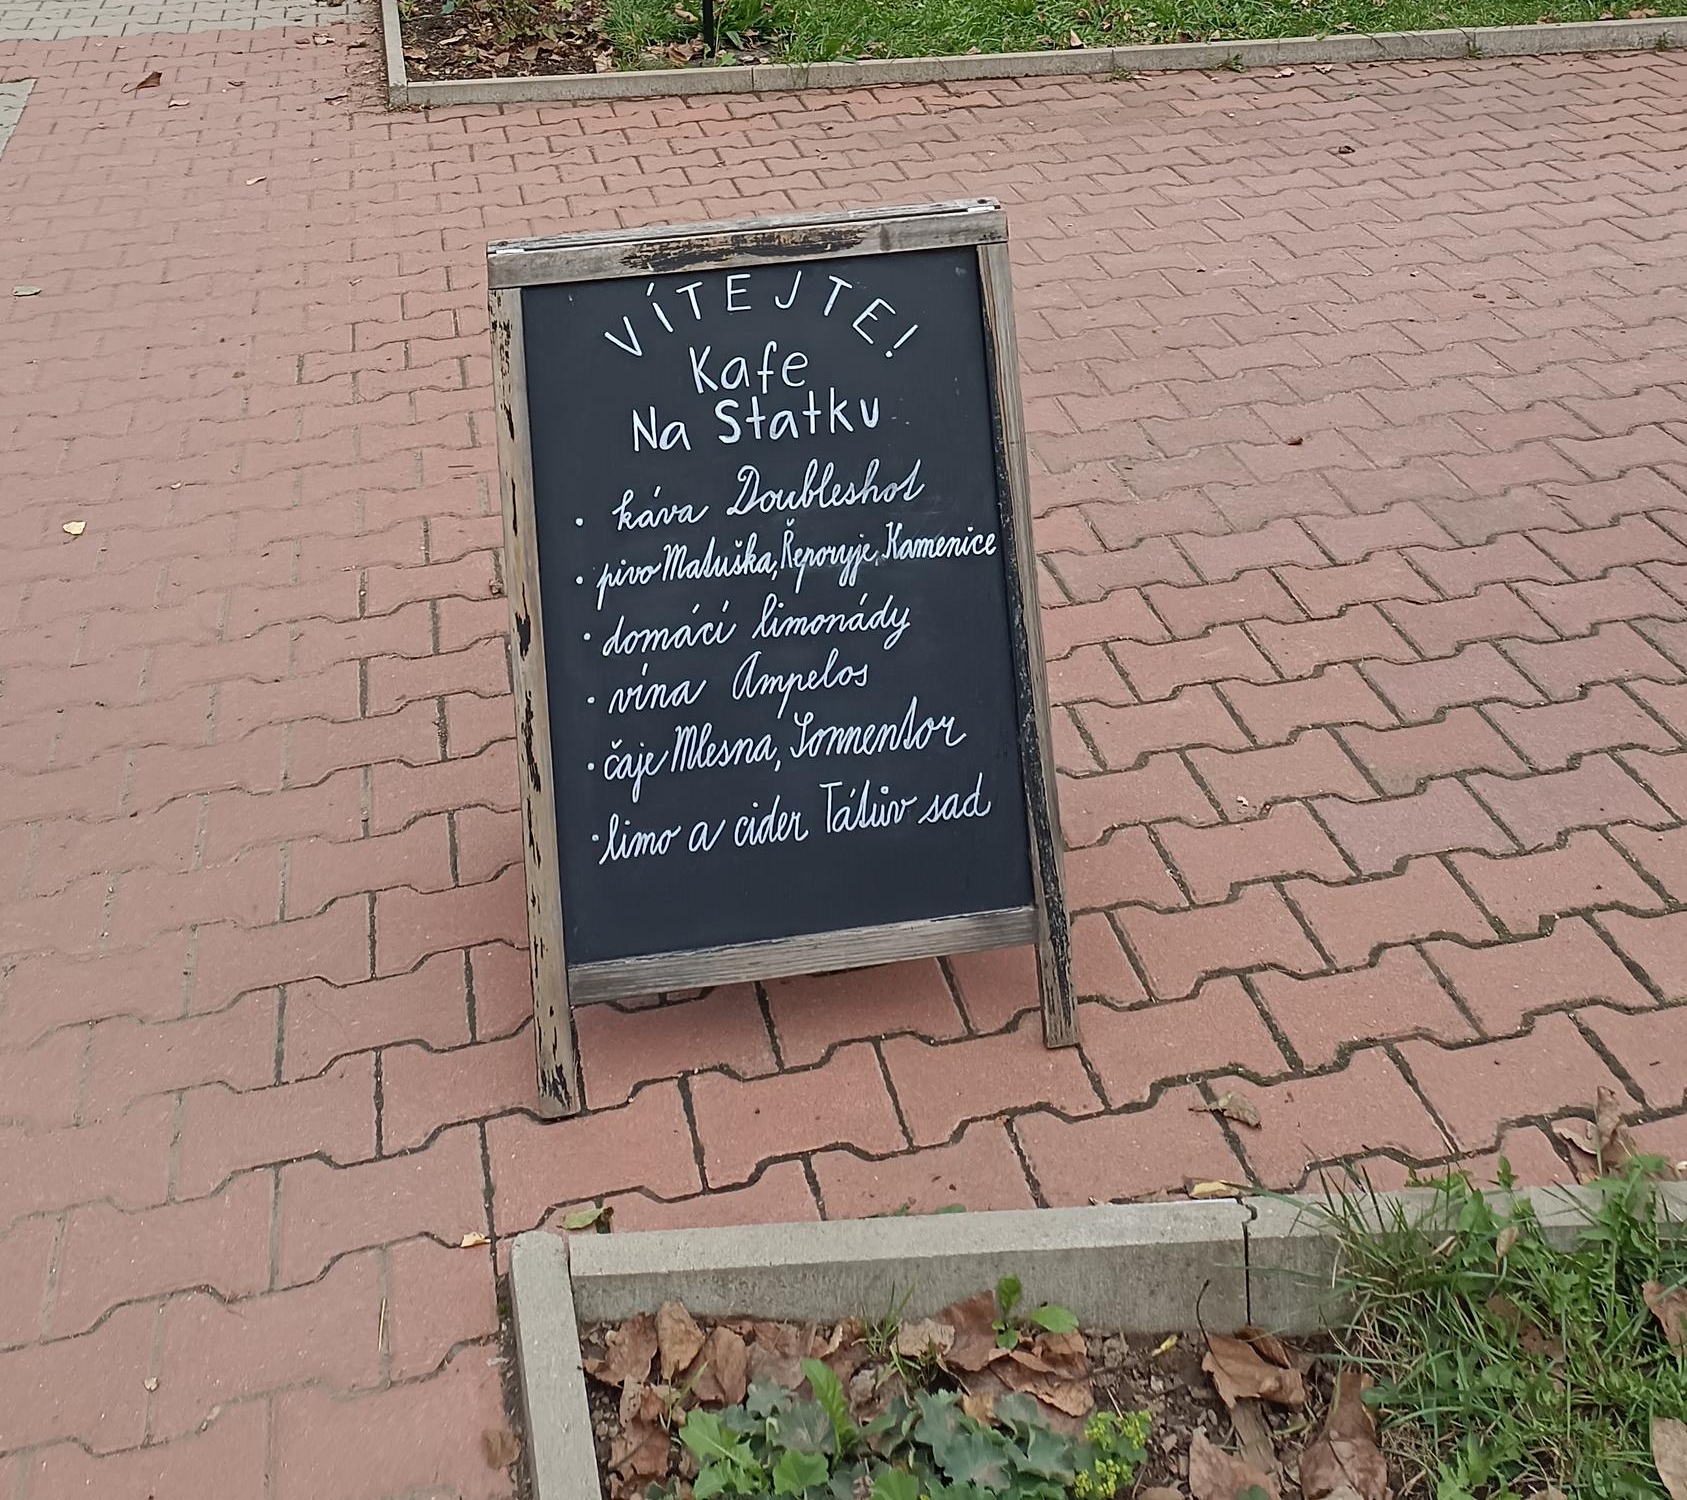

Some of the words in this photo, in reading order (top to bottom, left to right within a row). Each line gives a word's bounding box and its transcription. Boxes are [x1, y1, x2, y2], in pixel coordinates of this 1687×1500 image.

[604, 270, 919, 359] VÍTEJTE!
[689, 340, 808, 395] Kafe
[632, 406, 691, 453] Na
[716, 387, 880, 445] Statku
[612, 486, 710, 531] káva
[726, 458, 925, 517] Doubleshot
[596, 558, 662, 610] pivo
[882, 521, 997, 560] Kamenice
[602, 600, 737, 657] domácí
[752, 593, 911, 650] limonády
[608, 663, 707, 714] vína
[732, 648, 868, 719] Ampelos
[603, 739, 669, 803] čaje
[599, 813, 681, 865] limo
[688, 819, 726, 852] a
[734, 795, 809, 847] cider
[917, 772, 992, 824] sad
